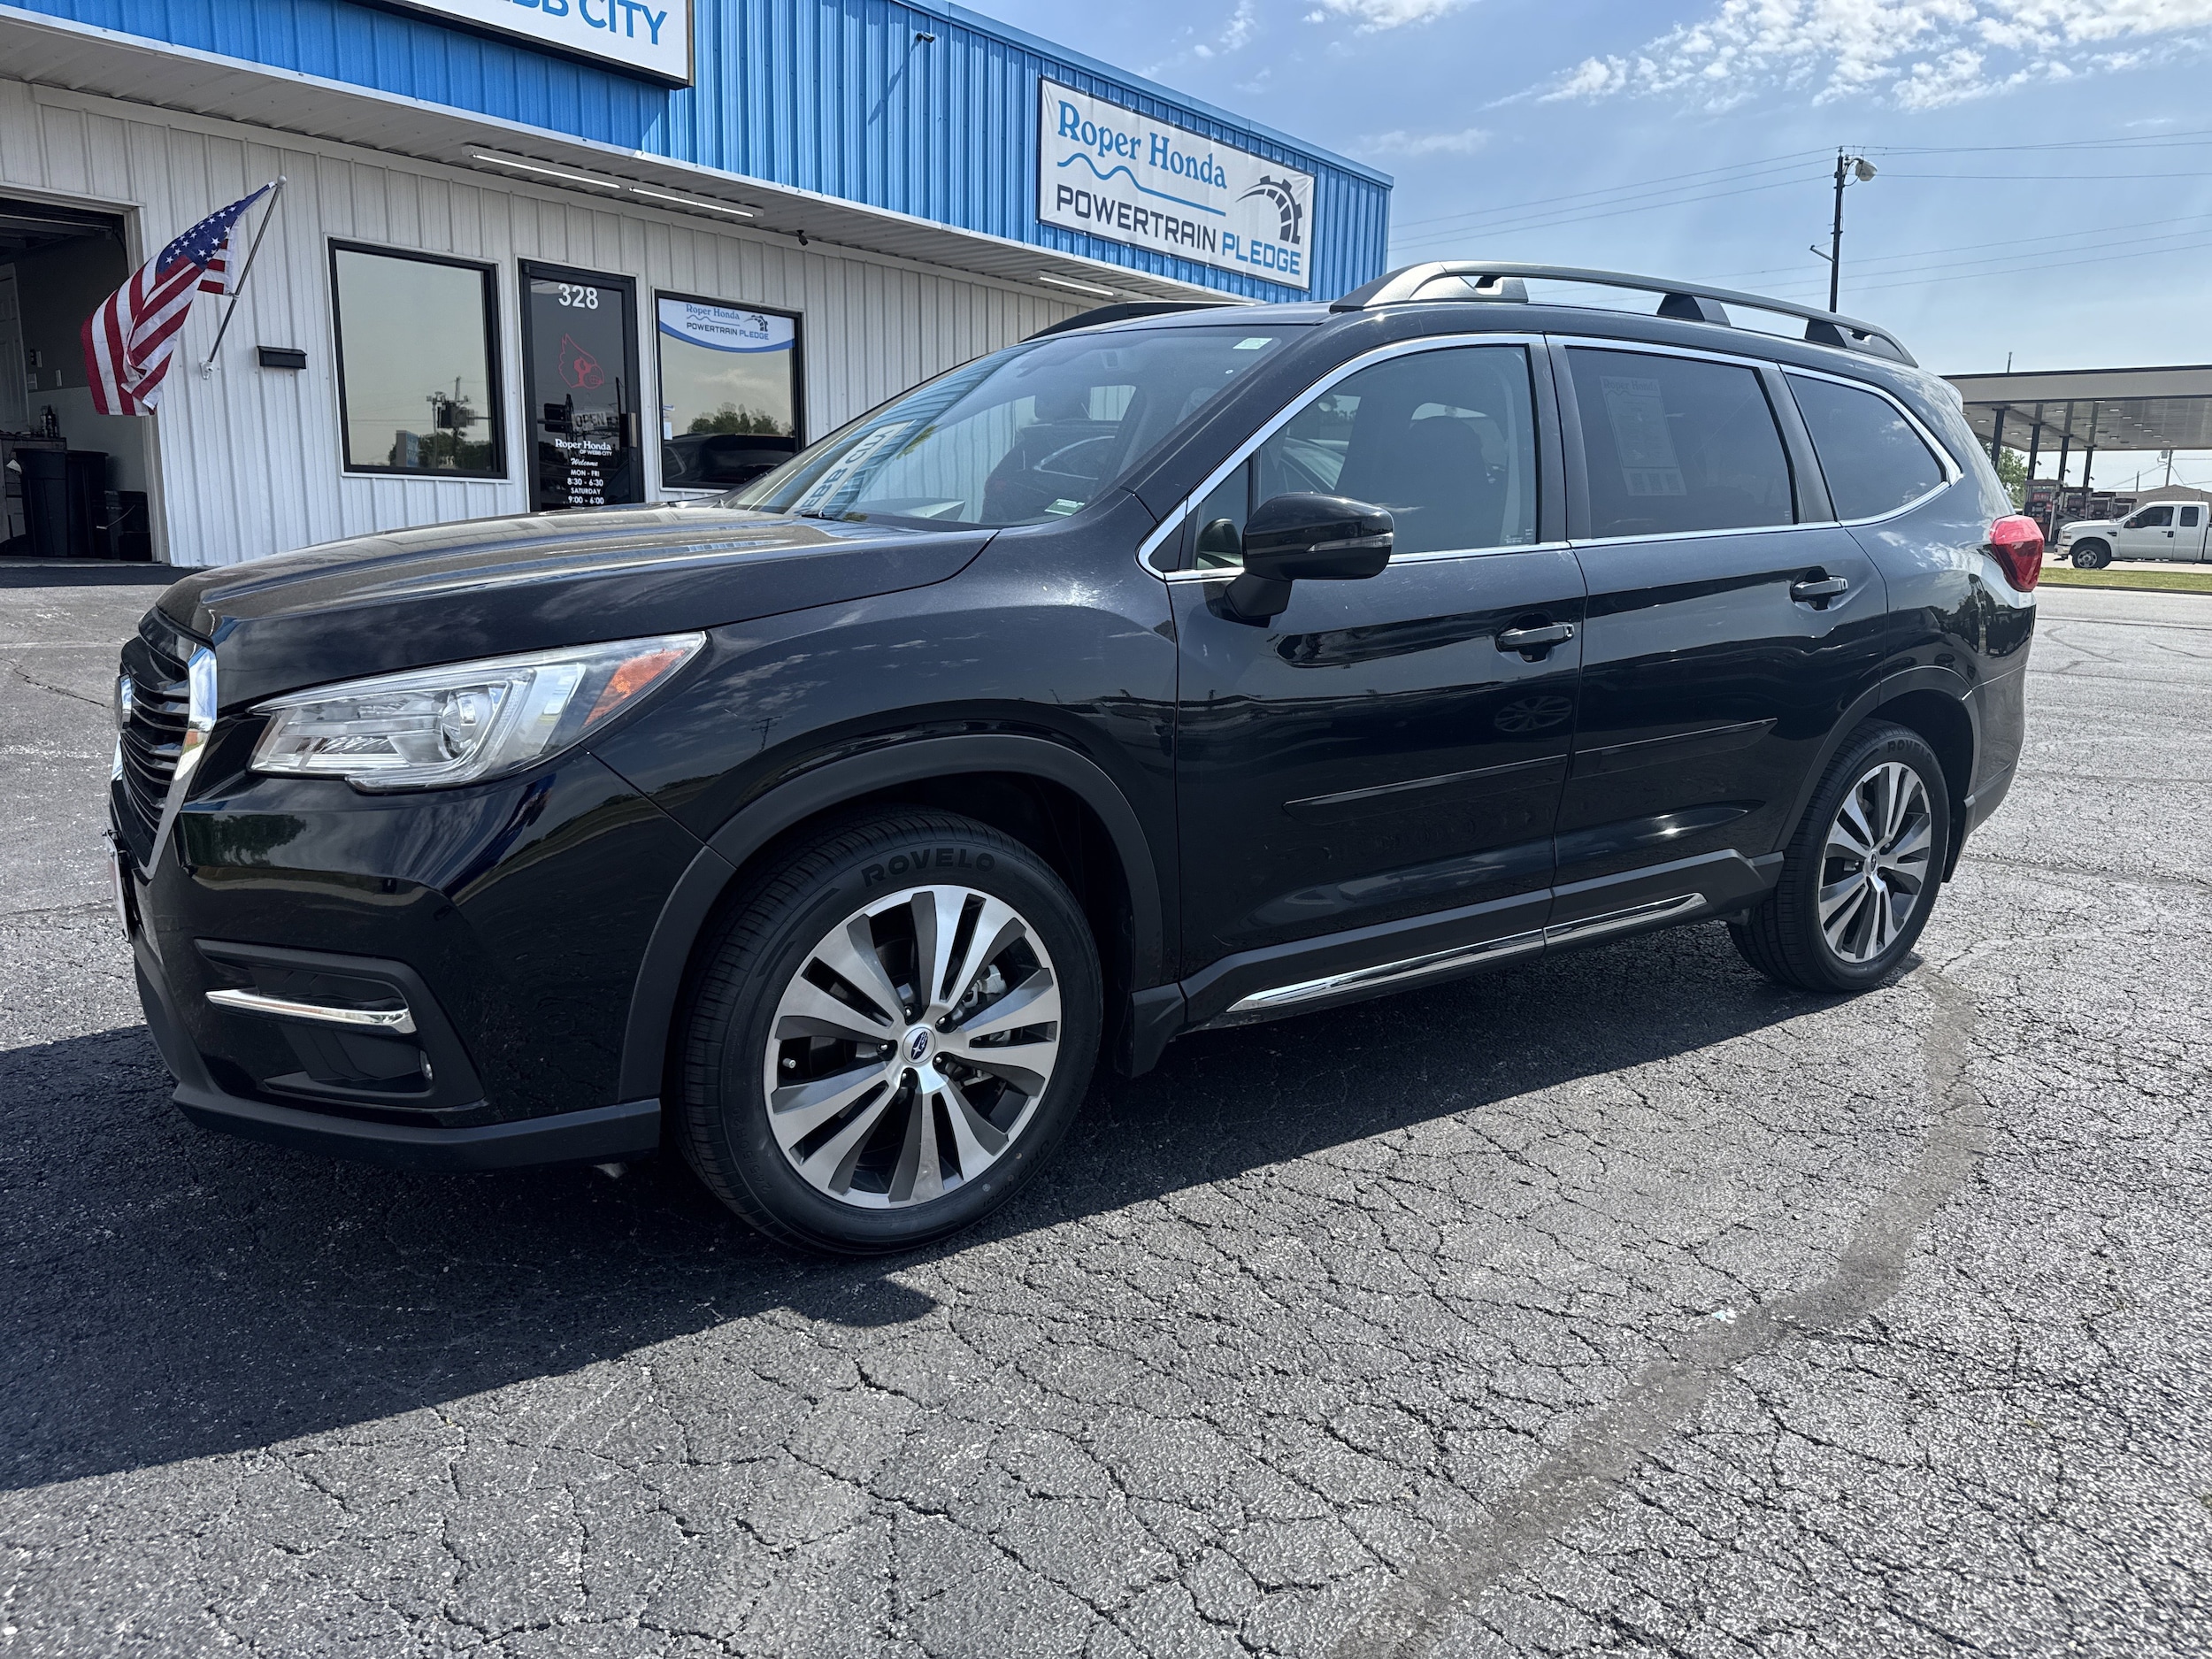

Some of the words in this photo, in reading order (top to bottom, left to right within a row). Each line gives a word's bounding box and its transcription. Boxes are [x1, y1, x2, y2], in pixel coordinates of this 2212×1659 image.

[579, 0, 668, 45] CITY
[1057, 100, 1141, 157] Roper
[1149, 132, 1227, 189] Honda
[1056, 184, 1217, 253] POWERTRAIN
[1222, 232, 1302, 276] PLEDGE
[557, 283, 599, 310] 328
[686, 303, 711, 316] Roper
[713, 309, 740, 319] Honda
[686, 322, 738, 335] POWERTRAIN
[739, 330, 769, 340] PLEDGE
[1603, 380, 1629, 391] Roper
[555, 439, 581, 449] Roper
[583, 441, 611, 451] Honda
[570, 457, 599, 467] Welcome
[861, 848, 995, 887] ROVELO
